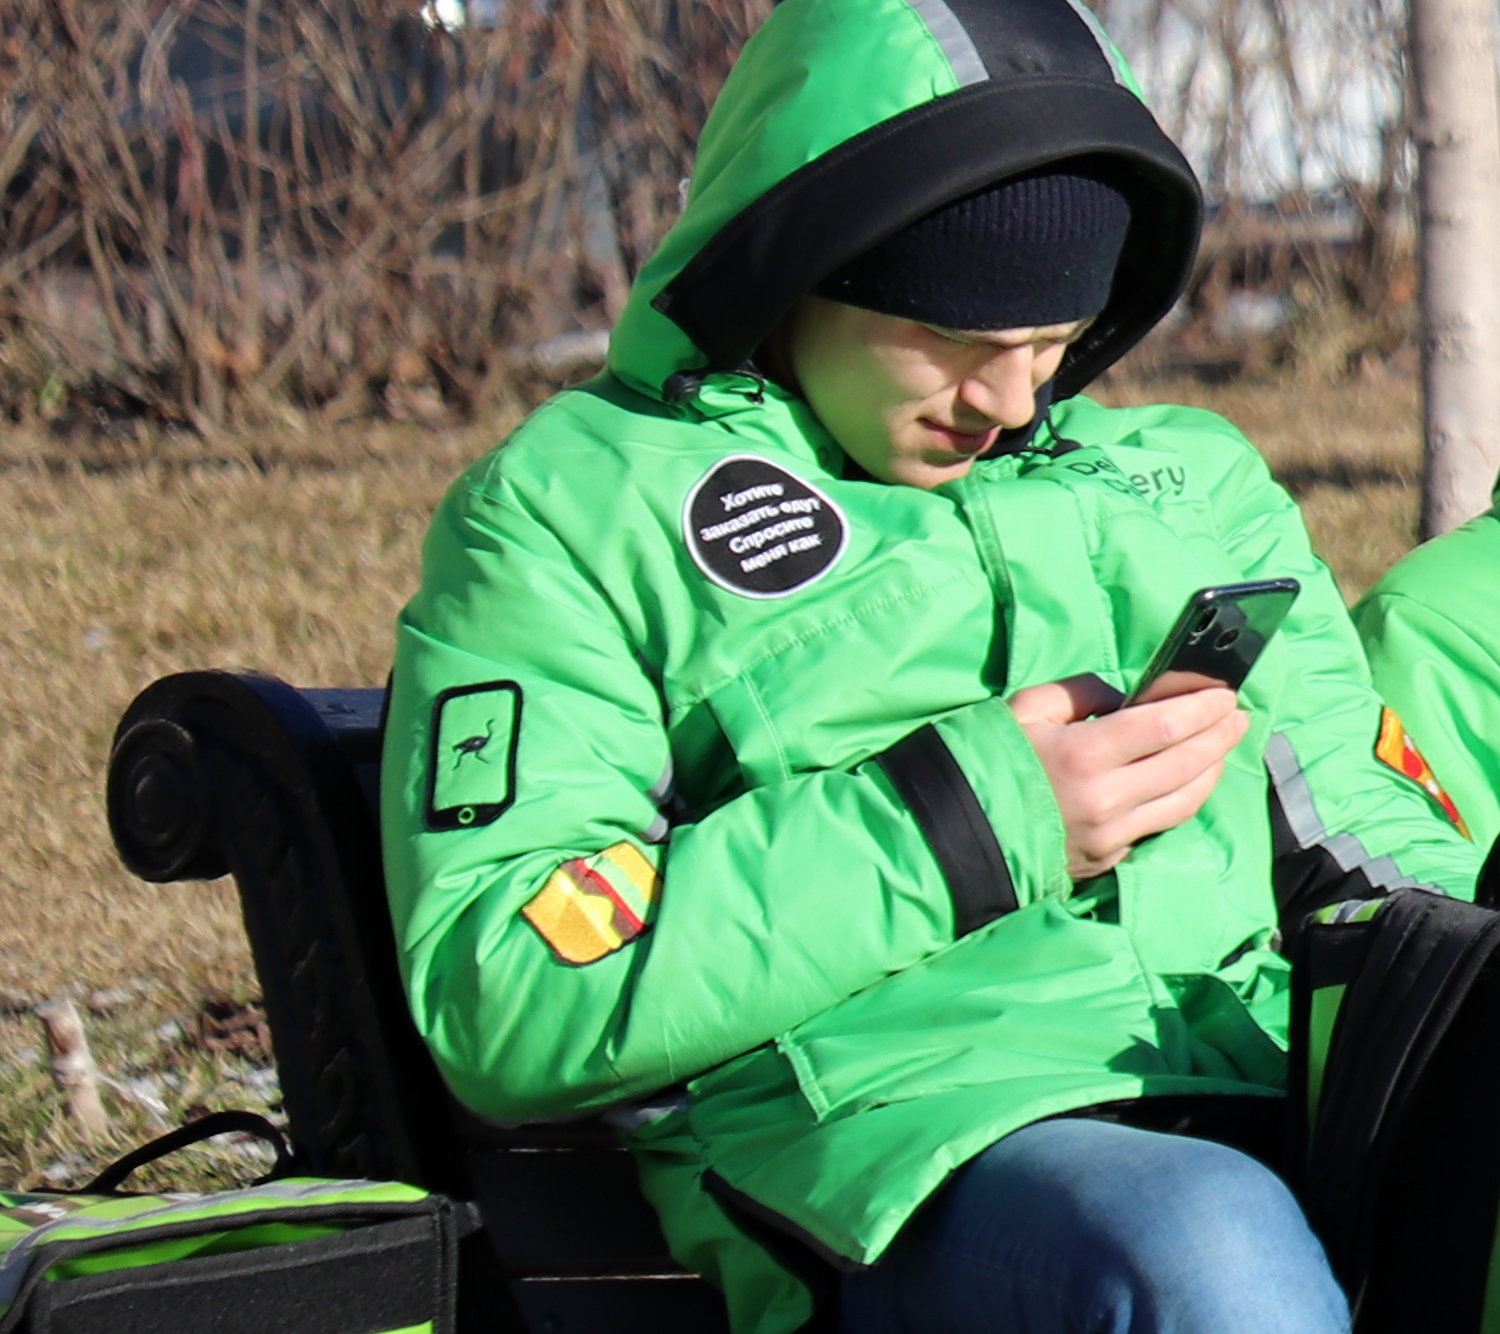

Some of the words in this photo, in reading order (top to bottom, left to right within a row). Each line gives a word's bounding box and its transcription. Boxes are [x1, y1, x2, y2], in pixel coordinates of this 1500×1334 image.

[719, 483, 785, 512] Хотите
[699, 505, 781, 542] заказать
[728, 516, 815, 554] Спросите
[739, 544, 789, 573] меня
[787, 534, 823, 554] как
